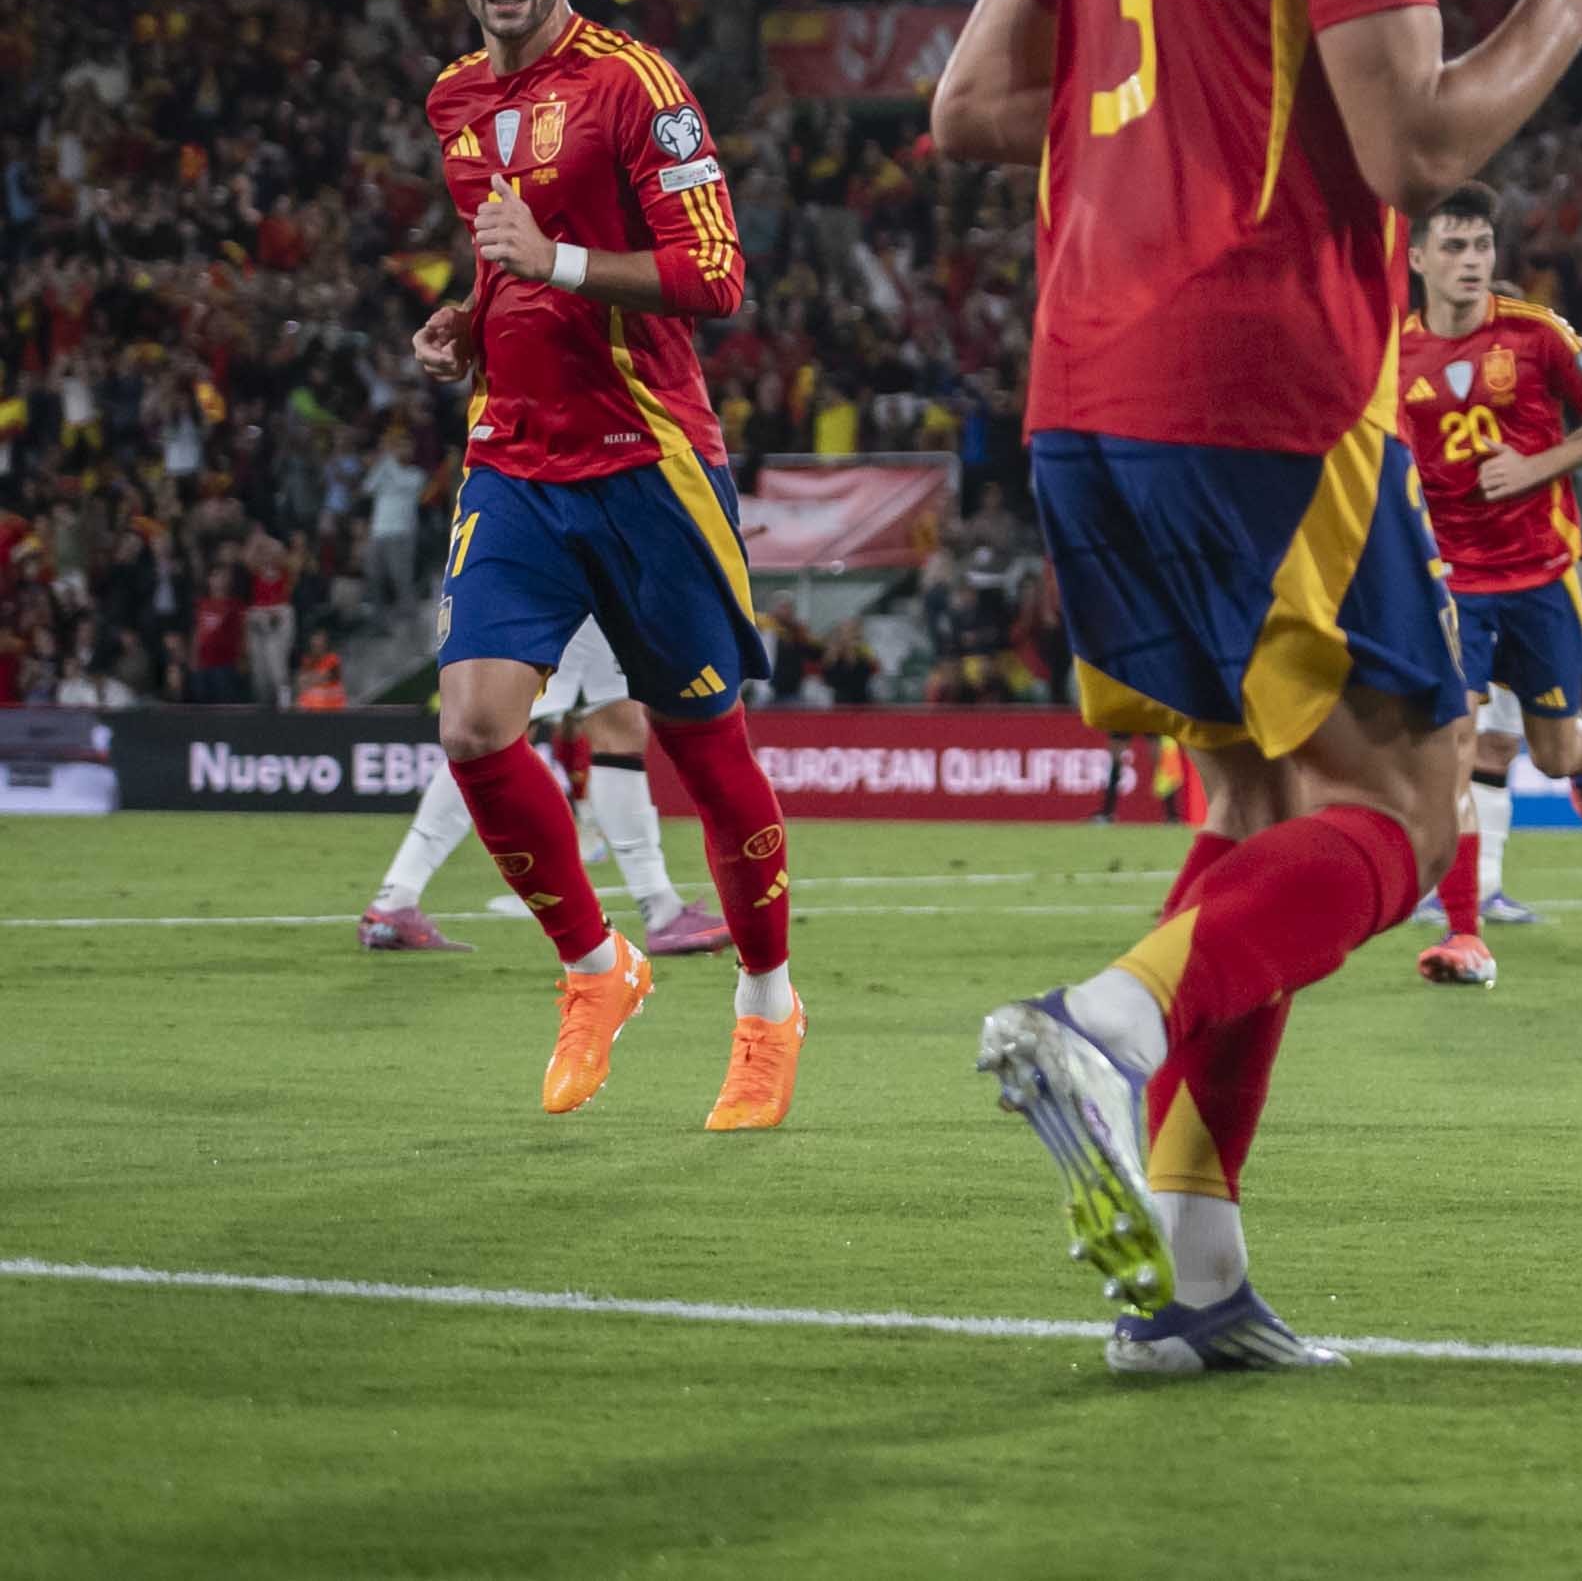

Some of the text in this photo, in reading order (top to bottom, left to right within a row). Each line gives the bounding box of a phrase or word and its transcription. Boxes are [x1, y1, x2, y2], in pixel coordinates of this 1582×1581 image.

[1439, 404, 1503, 463] 20
[189, 741, 340, 795] Nuevo
[755, 746, 937, 794] EUROPEAN
